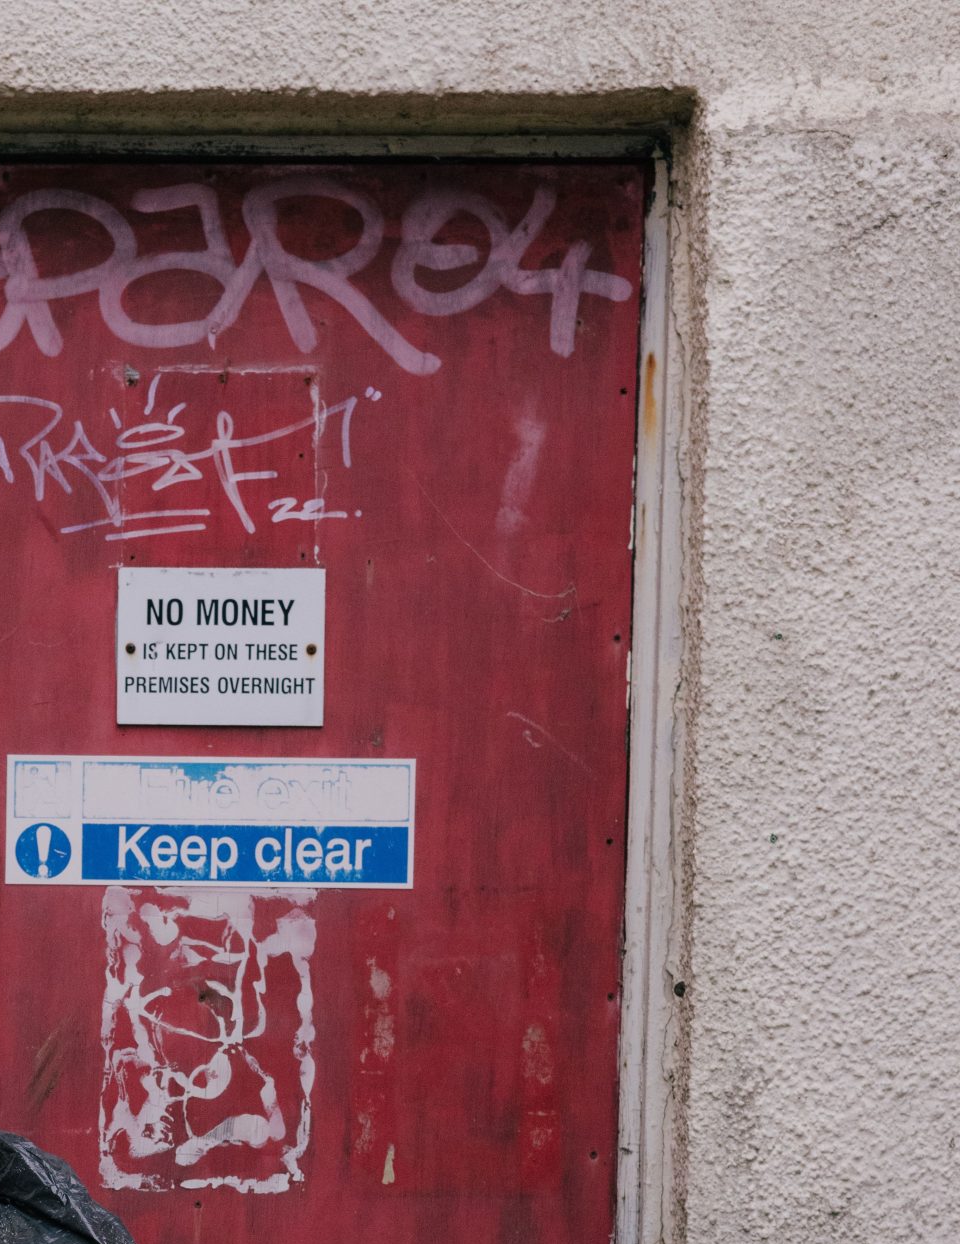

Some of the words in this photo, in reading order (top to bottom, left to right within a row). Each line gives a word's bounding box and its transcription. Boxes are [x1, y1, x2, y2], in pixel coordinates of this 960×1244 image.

[145, 598, 184, 626] NO
[195, 598, 296, 627] MONEY
[142, 643, 159, 661] IS
[165, 643, 209, 661] KEPT
[214, 643, 239, 661] ON
[245, 643, 299, 662] THESE
[124, 676, 210, 695] PREMISES
[217, 676, 316, 696] OVERNIGHT
[118, 825, 239, 880] Keep
[254, 827, 372, 872] clear
